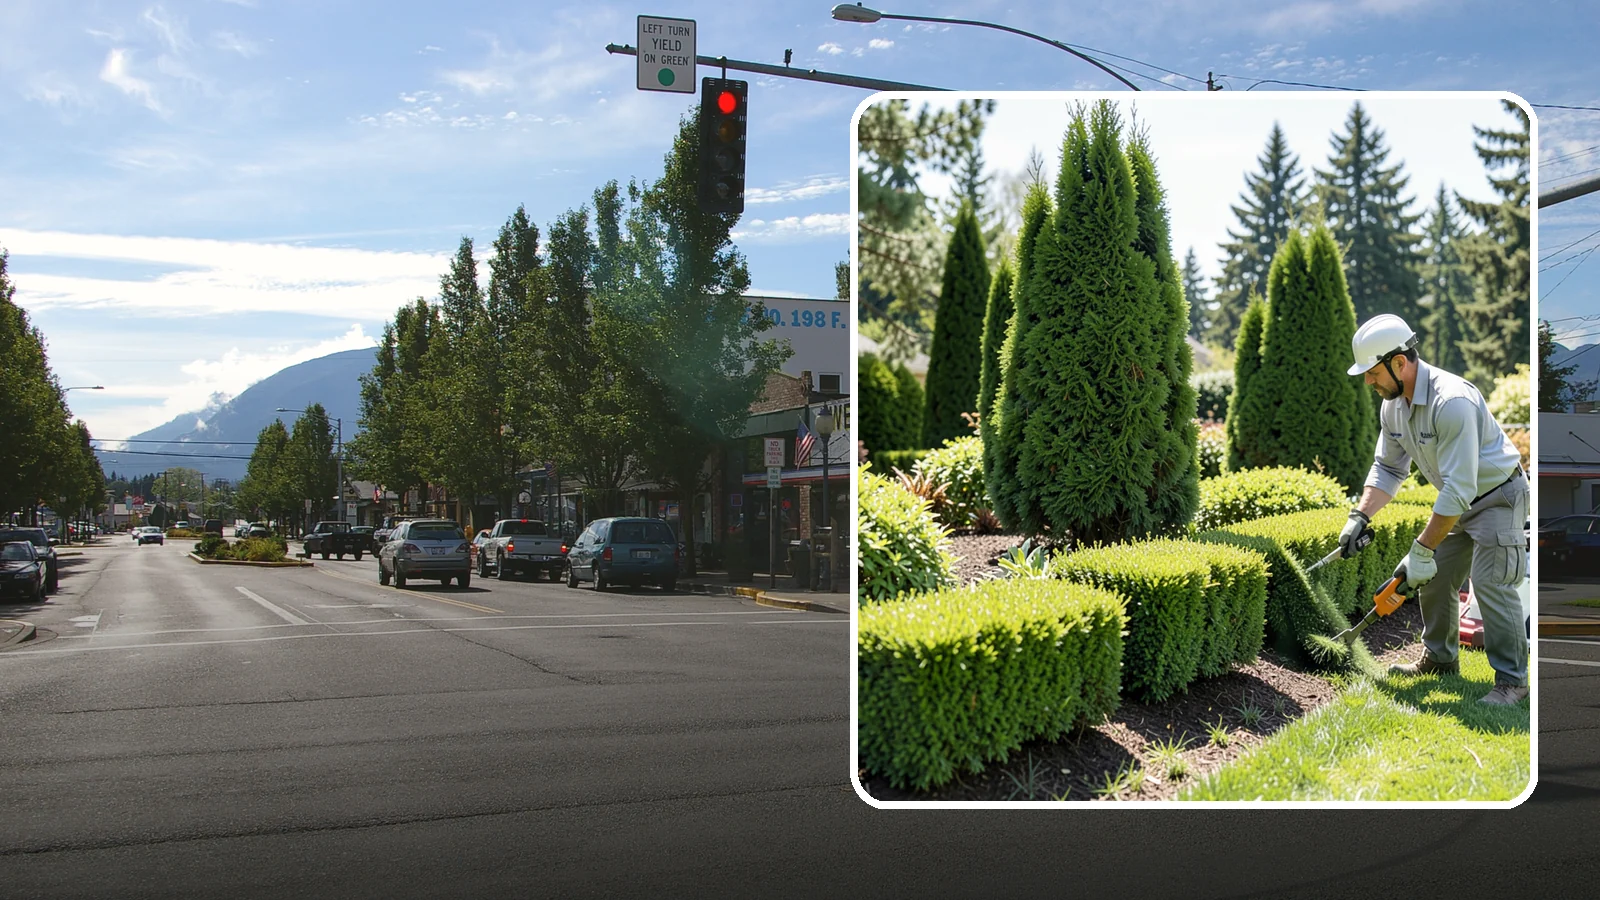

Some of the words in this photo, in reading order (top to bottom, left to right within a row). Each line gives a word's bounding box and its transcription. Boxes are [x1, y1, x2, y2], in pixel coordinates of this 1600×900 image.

[643, 23, 663, 34] LEFT
[668, 25, 690, 36] TURN
[652, 38, 682, 51] YIELD
[644, 53, 656, 63] ON
[661, 54, 689, 66] GREEN
[791, 309, 826, 328] 198
[831, 311, 846, 328] F.
